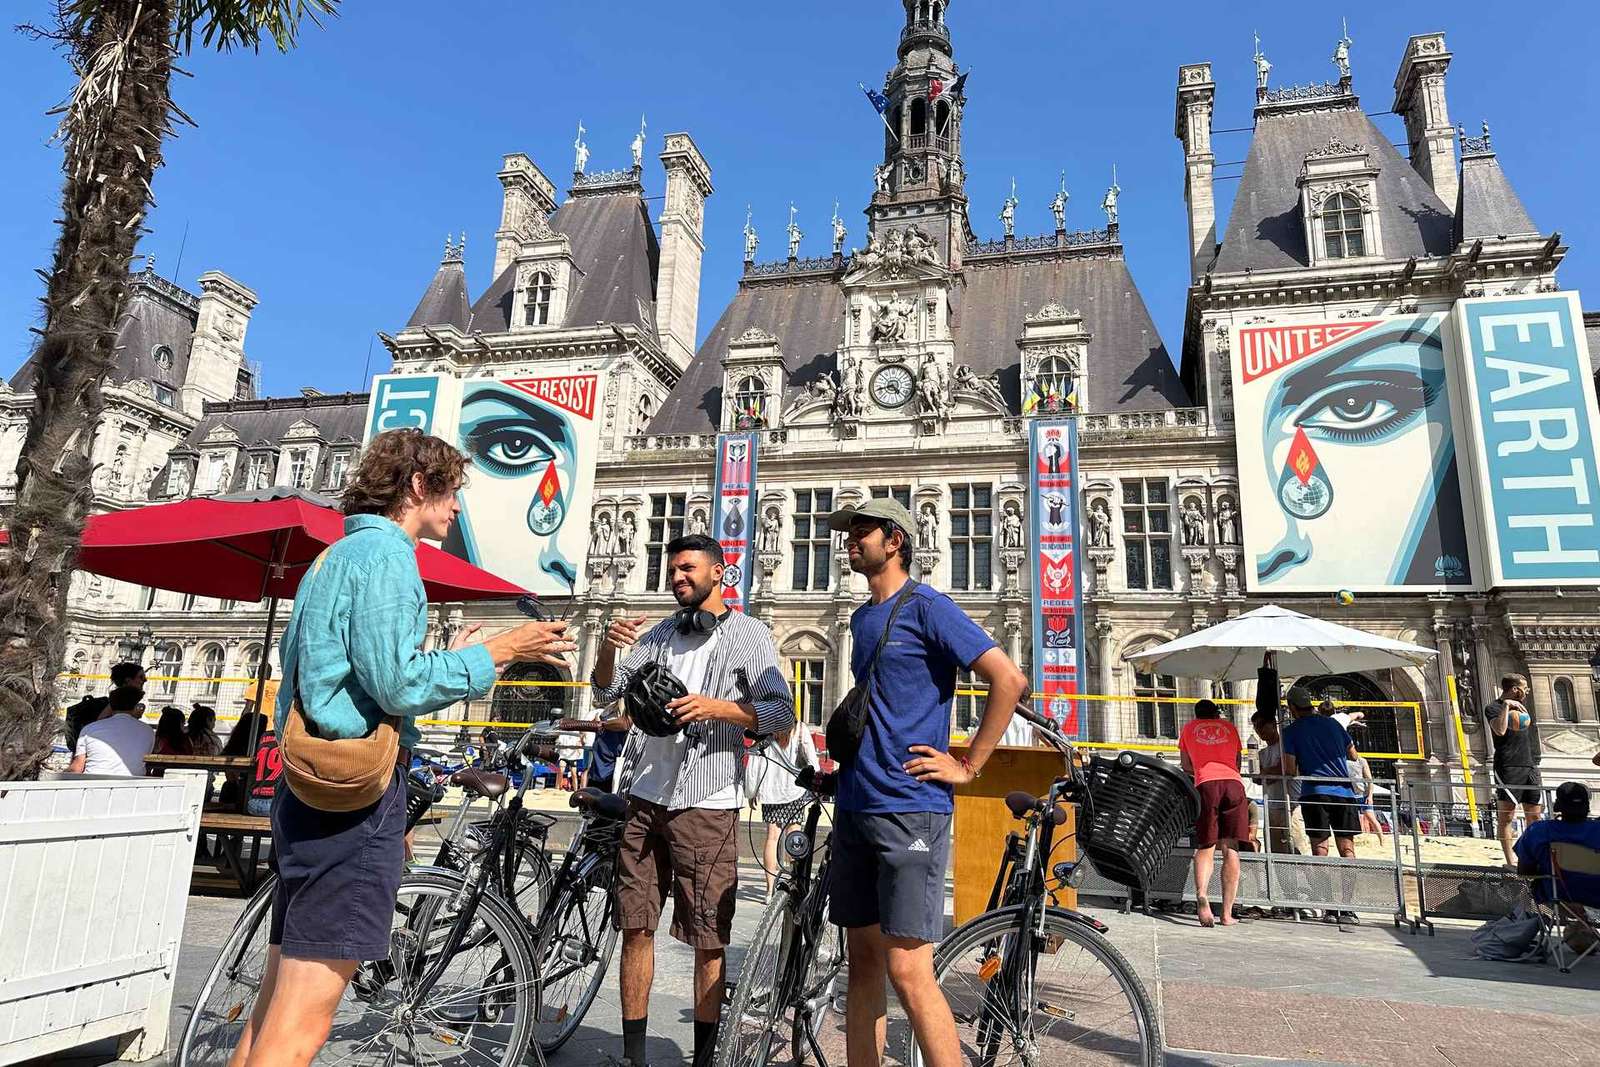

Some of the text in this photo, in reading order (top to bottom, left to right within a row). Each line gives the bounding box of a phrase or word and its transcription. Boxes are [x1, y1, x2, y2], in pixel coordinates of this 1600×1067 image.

[1244, 328, 1323, 376] UNITE
[539, 376, 595, 415] RESIST
[1478, 311, 1600, 564] EARTH
[256, 746, 284, 781] 19
